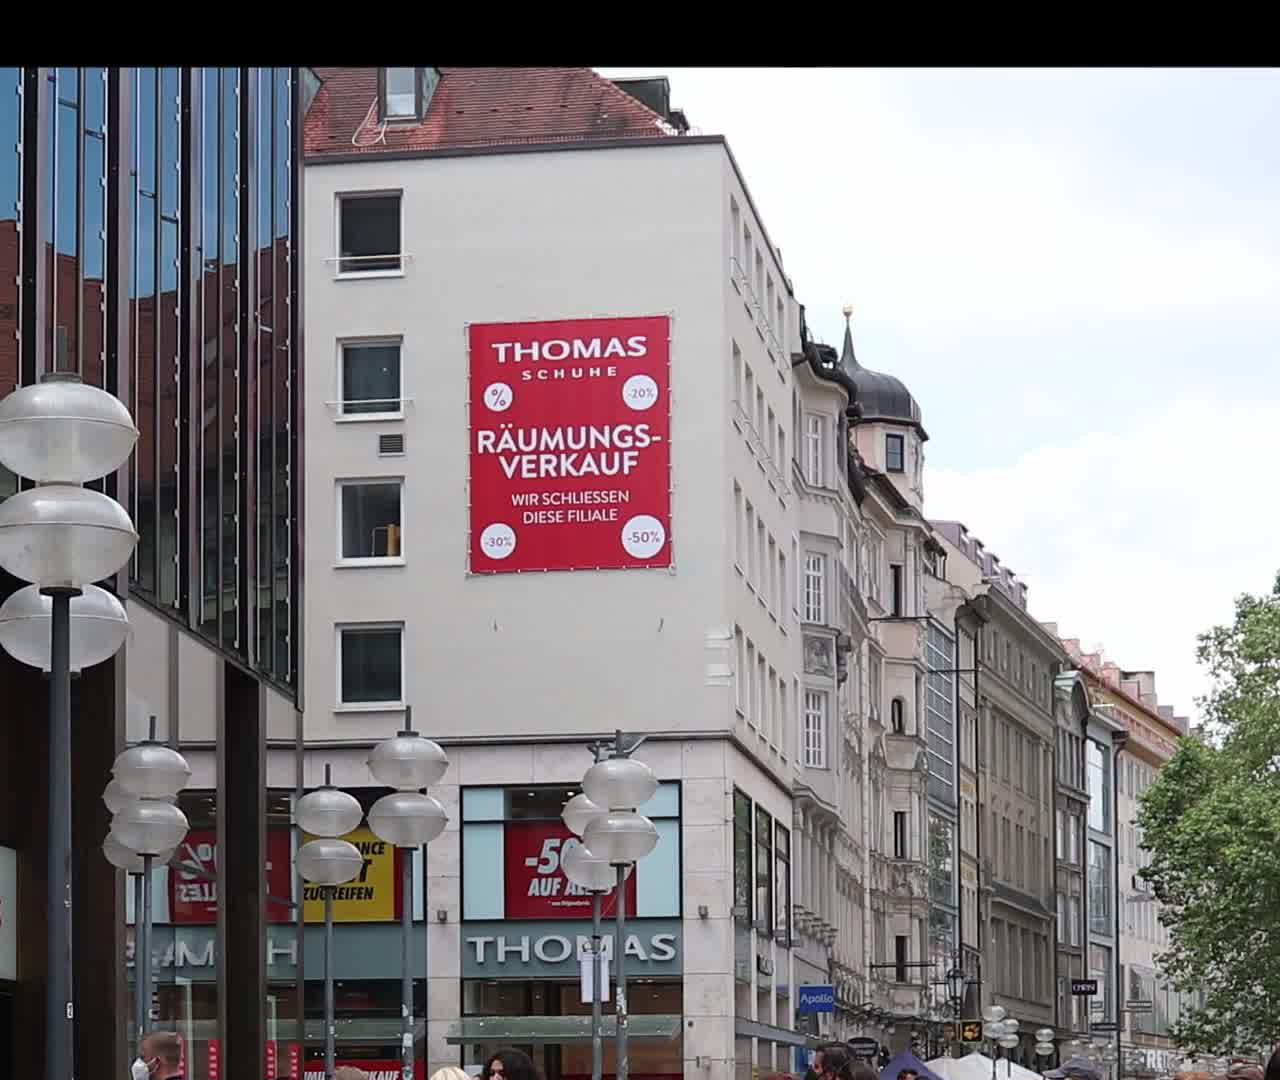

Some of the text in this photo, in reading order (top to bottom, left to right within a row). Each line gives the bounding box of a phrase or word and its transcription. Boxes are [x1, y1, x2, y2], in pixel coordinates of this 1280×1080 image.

[491, 335, 648, 363] THOMAS
[521, 366, 618, 381] SCHUHE
[491, 387, 506, 408] %
[627, 386, 655, 399] -20%
[477, 422, 662, 454] RÄUMUNGS-
[498, 451, 640, 479] VERKAUF
[511, 490, 630, 507] WIR SCHLIESSEN
[523, 508, 618, 525] DIESE FILIALE
[484, 536, 512, 548] -30%
[627, 531, 661, 544] -50%
[528, 878, 561, 896] AUF
[466, 934, 677, 964] THOMAS
[801, 993, 834, 1005] Apollo
